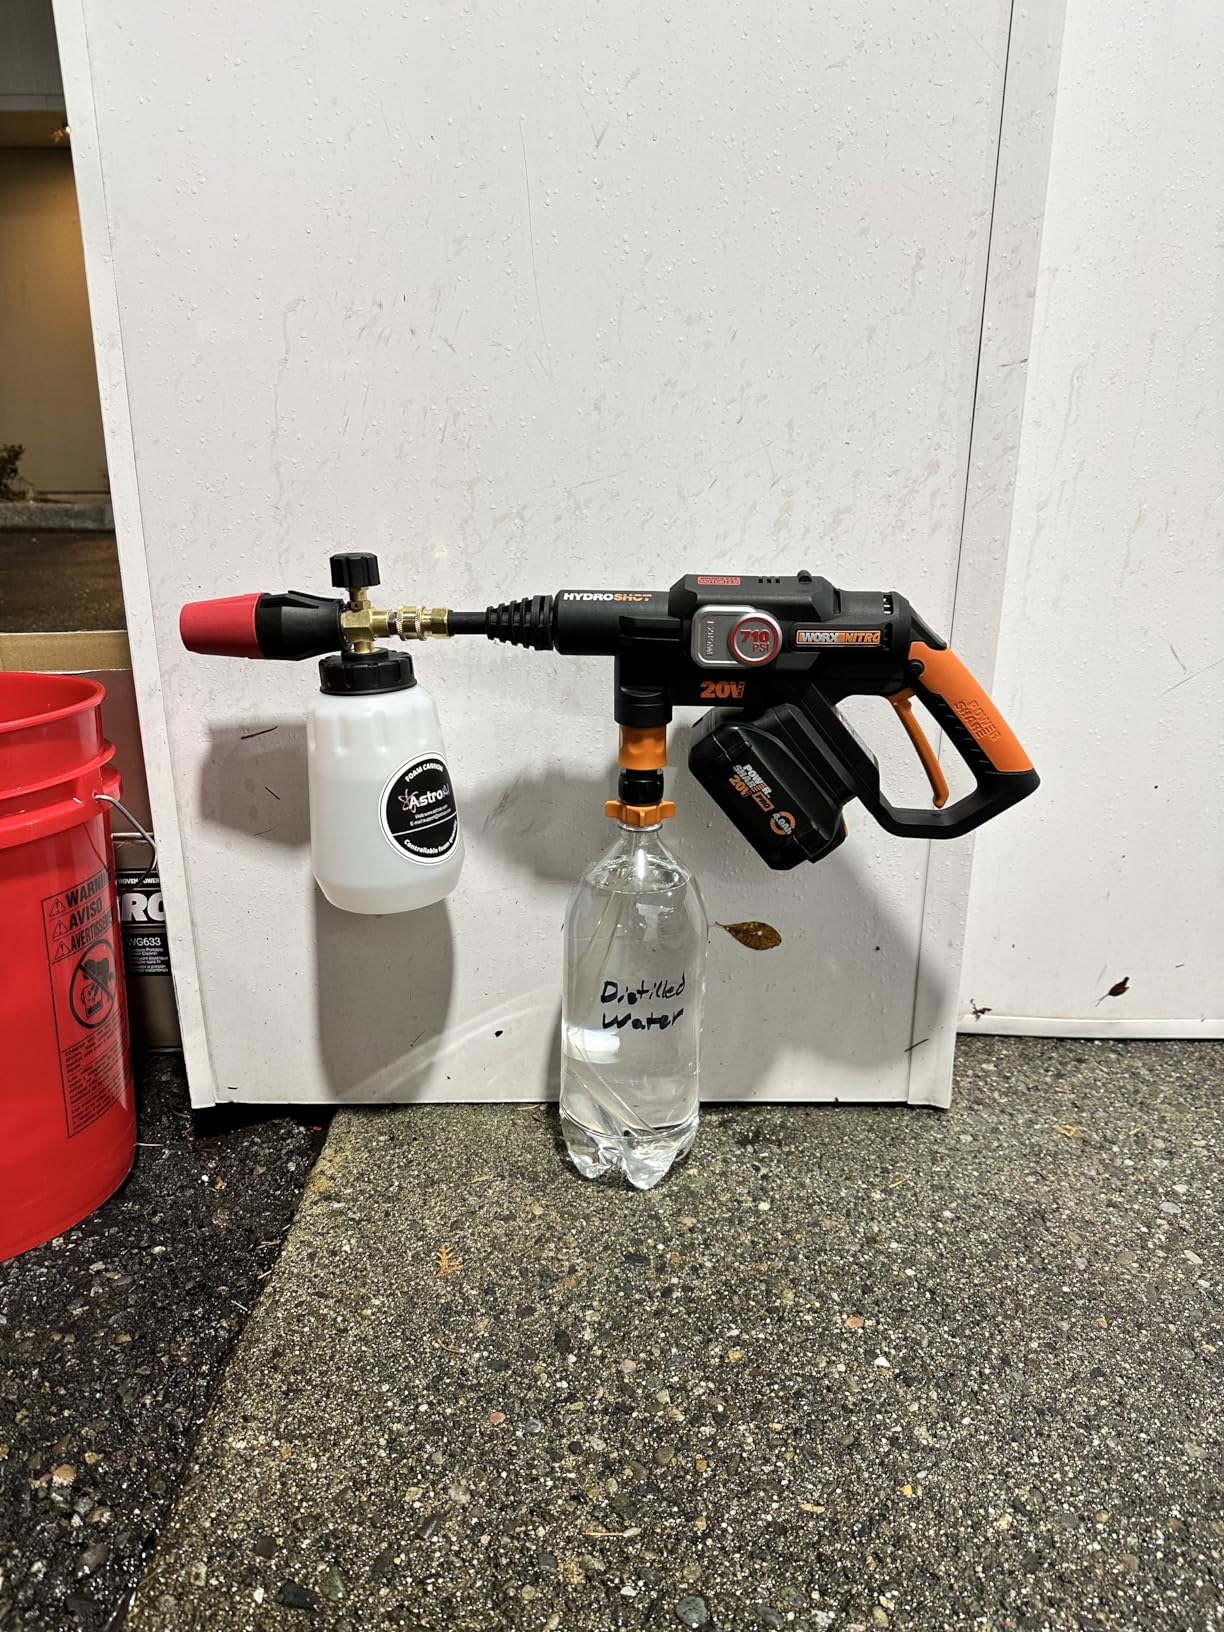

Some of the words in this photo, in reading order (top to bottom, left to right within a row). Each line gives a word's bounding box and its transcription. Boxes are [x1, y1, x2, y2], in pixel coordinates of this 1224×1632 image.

[740, 629, 770, 643] 710
[845, 632, 880, 644] NITRO
[700, 681, 745, 698] 20V
[955, 700, 988, 739] SHARE
[968, 700, 1001, 742] POWER
[404, 765, 423, 783] FOAM
[728, 774, 753, 798] 20V
[732, 764, 762, 794] SHARE
[743, 763, 773, 798] POWER
[66, 868, 109, 908] WARNI
[69, 897, 102, 930] AVISO
[117, 892, 166, 921] RO
[128, 937, 161, 946] WG633
[600, 970, 686, 1005] Distilled
[602, 1008, 684, 1031] Water
